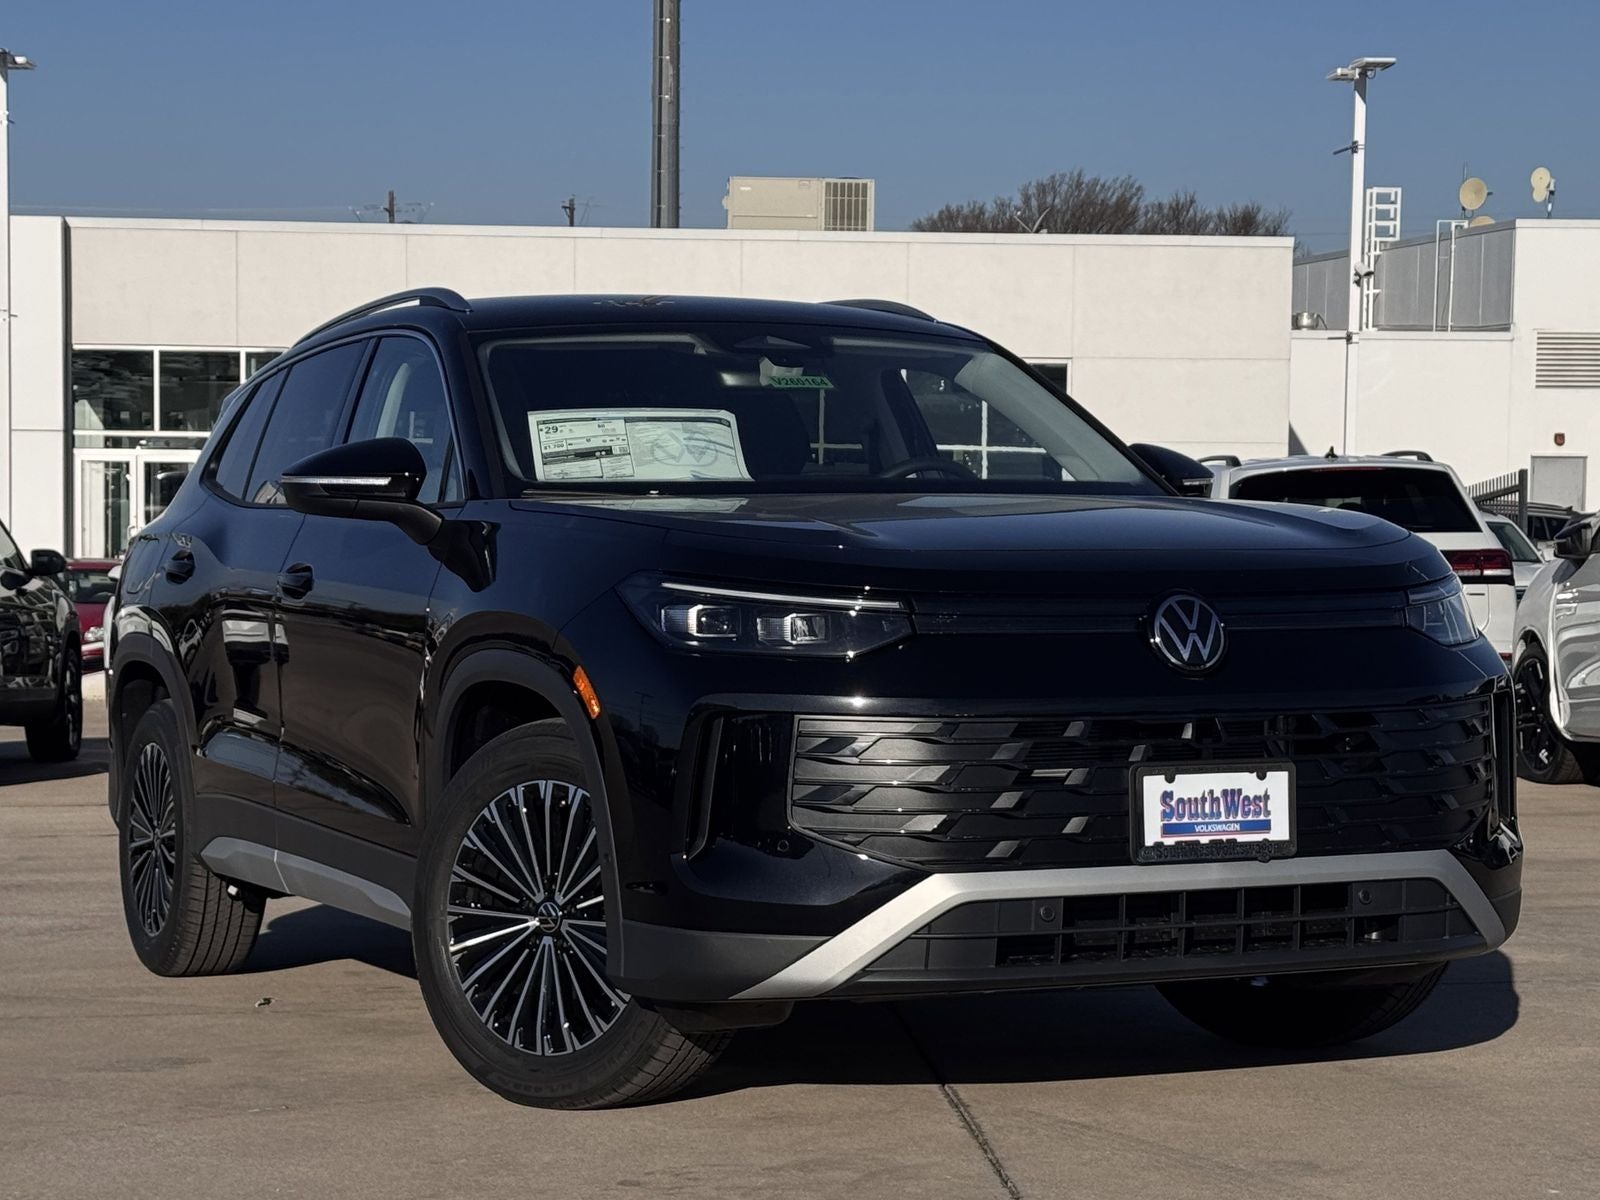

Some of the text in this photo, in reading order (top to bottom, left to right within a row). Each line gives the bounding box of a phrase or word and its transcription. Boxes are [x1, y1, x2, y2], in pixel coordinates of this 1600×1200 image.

[544, 425, 559, 435] 29
[1155, 595, 1223, 668] VW
[1160, 787, 1271, 822] SouthWest
[1194, 822, 1241, 833] VOLKSWAGEN
